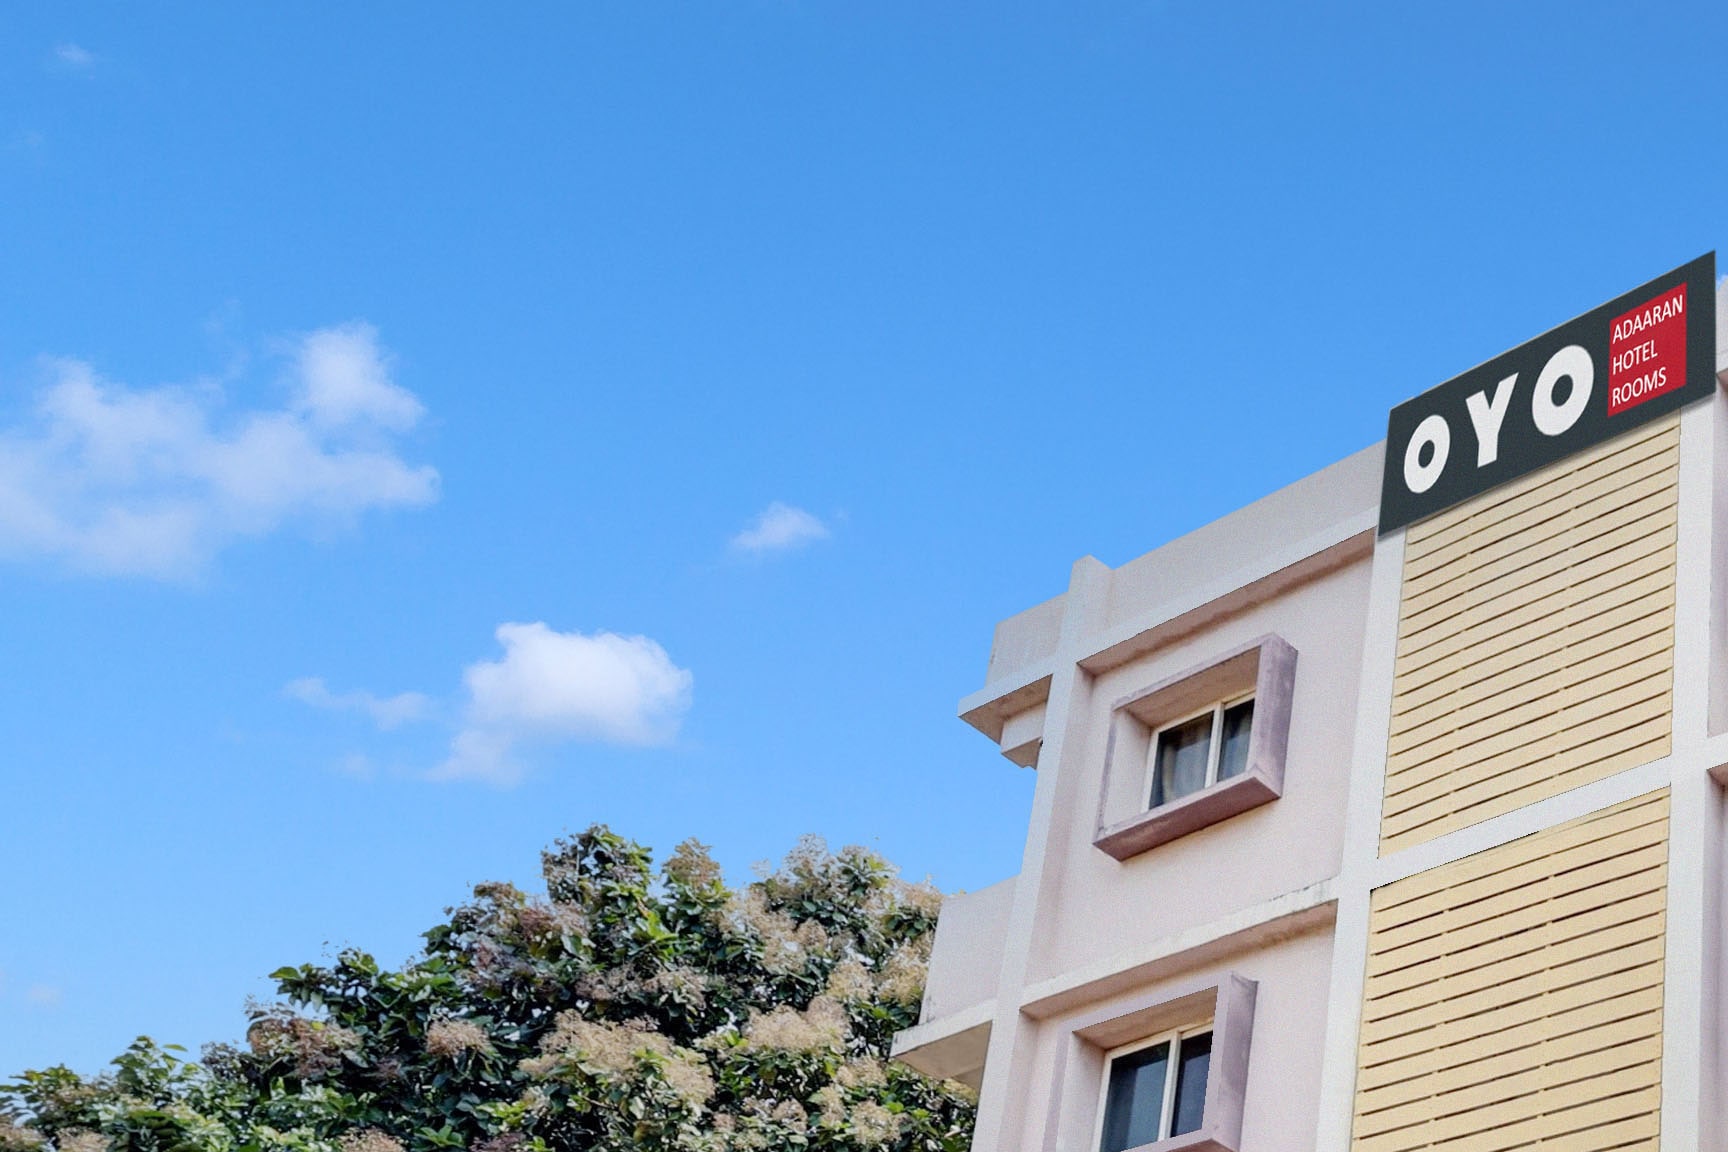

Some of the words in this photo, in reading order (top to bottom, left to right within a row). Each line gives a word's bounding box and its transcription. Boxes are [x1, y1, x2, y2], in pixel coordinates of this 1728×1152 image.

[1612, 294, 1683, 344] ADAARAN
[1612, 340, 1658, 375] HOTEL
[1611, 367, 1667, 408] ROOMS
[1404, 344, 1594, 494] OYO
